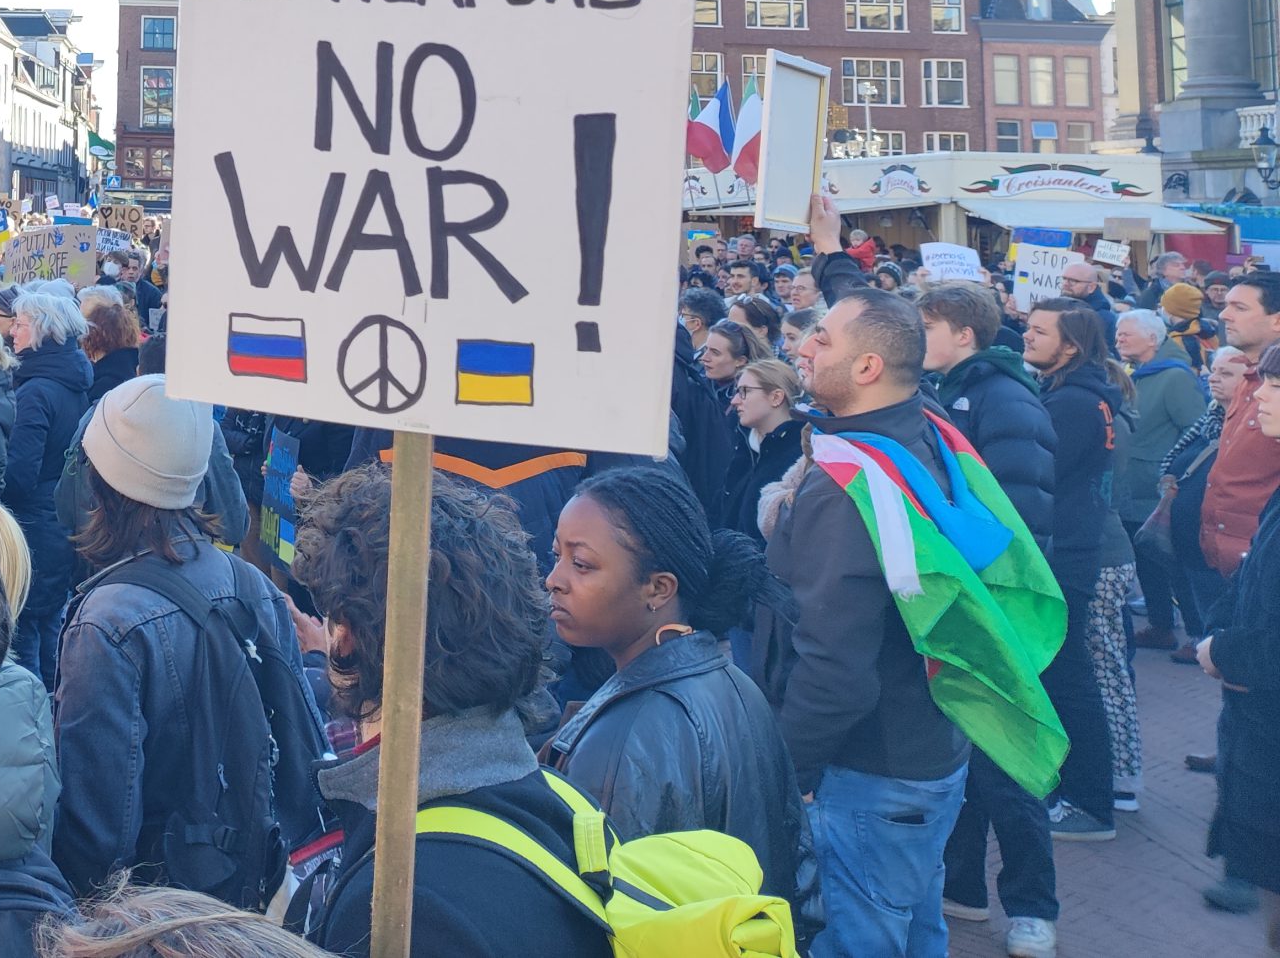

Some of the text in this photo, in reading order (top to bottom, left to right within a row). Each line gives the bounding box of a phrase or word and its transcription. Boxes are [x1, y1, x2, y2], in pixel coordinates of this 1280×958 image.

[314, 39, 476, 161] NO
[1003, 175, 1111, 195] Croissanterie
[115, 208, 141, 224] NO
[213, 151, 530, 304] WAR
[48, 252, 69, 272] OFF
[1031, 250, 1068, 270] STOP
